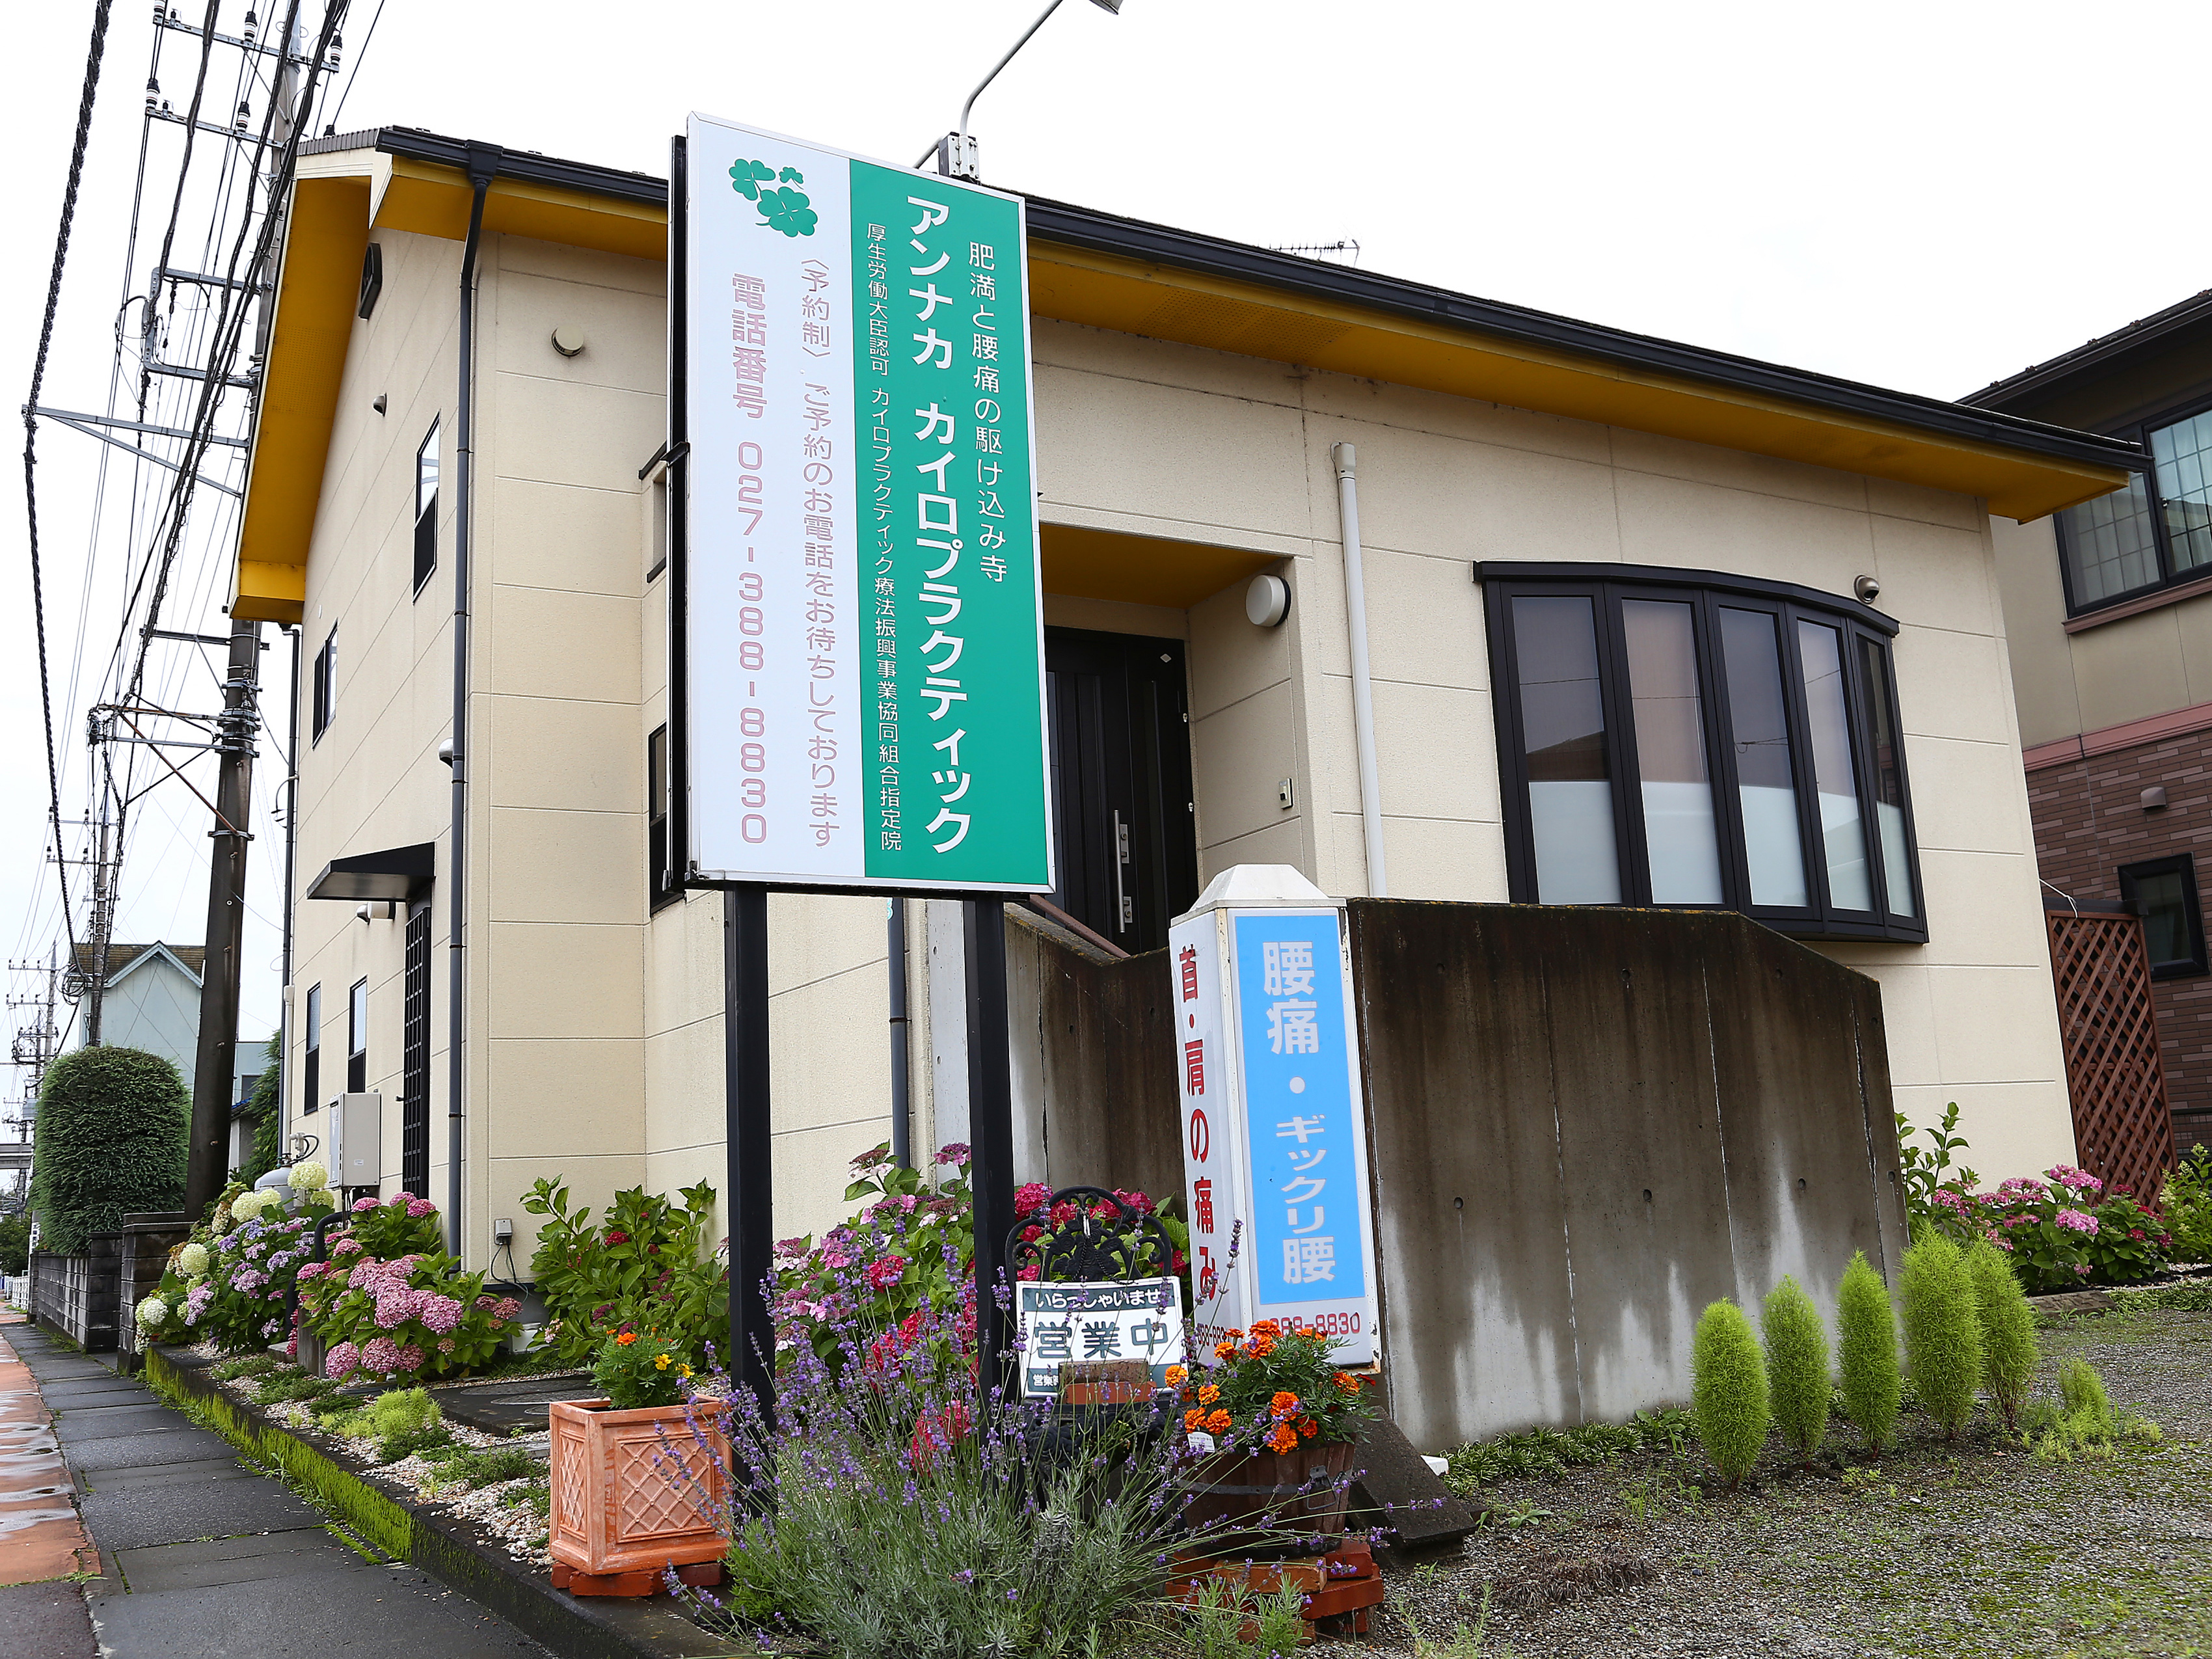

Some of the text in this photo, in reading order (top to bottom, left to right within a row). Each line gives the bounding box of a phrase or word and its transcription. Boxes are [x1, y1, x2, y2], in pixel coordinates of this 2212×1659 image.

[731, 272, 768, 844] 電話番号 027-388-8830
[867, 223, 902, 852] 厚生労働大臣認可 カイロプラクティック療法振興事業協同組合指定院
[906, 195, 972, 854] アンナカ カイロプラクティック
[968, 241, 1008, 583] 肥満と腰痛の駆け込み寺
[803, 382, 841, 848] ご予約のお電話をお待ちしております
[1179, 943, 1218, 1301] 首・肩の痛み
[1261, 941, 1336, 1286] 腰痛・ギックリ腰
[1034, 1317, 1168, 1359] 営業中
[1035, 1288, 1162, 1309] いらっしゃいませ
